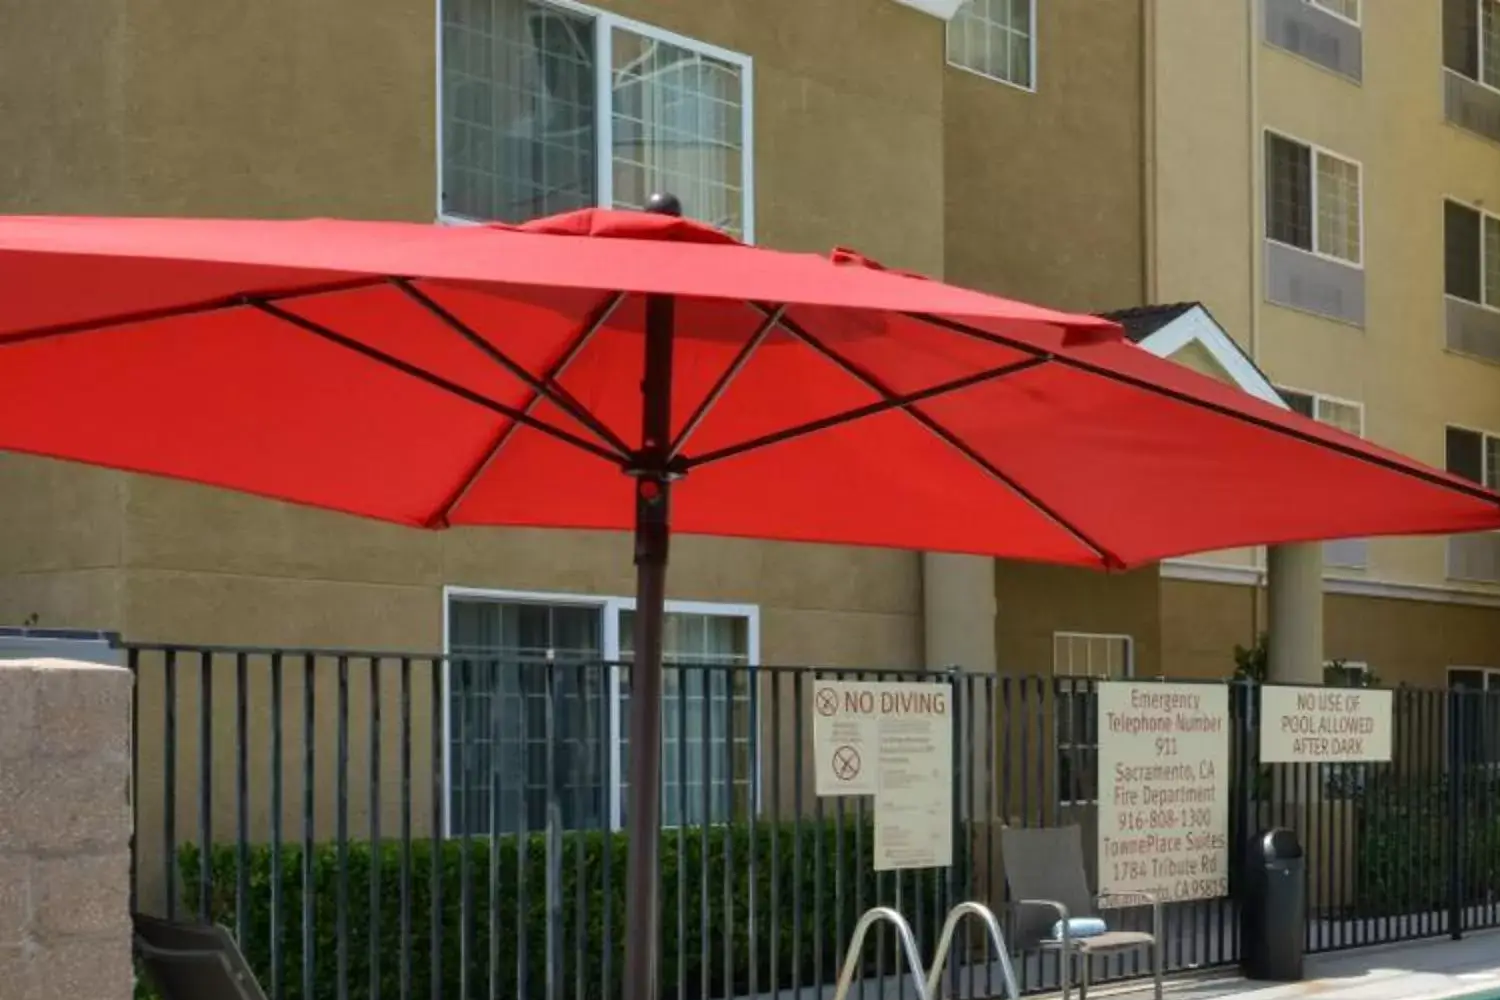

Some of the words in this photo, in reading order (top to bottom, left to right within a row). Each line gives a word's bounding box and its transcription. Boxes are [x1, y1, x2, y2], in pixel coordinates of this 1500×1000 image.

[844, 691, 874, 714] NO
[881, 692, 945, 714] DIVING
[1131, 689, 1200, 712] Emergency
[1297, 693, 1316, 711] NO
[1319, 693, 1342, 712] USE
[1107, 712, 1173, 735] Telephone
[1175, 712, 1222, 733] Number
[1281, 715, 1316, 734] POOL
[1319, 716, 1374, 734] ALLOWED
[1155, 737, 1178, 755] 911
[1293, 738, 1329, 755] AFTER
[1332, 738, 1364, 755] DARK
[1115, 761, 1196, 782] Sacramento,
[1199, 759, 1215, 779] CA
[1115, 786, 1138, 806] Fire
[1143, 785, 1216, 806] Department
[1104, 834, 1182, 857] TownePlace
[1186, 831, 1225, 851] Suites
[1114, 859, 1147, 881] 1784
[1152, 857, 1197, 878] Tribute
[1201, 853, 1217, 874] Rd
